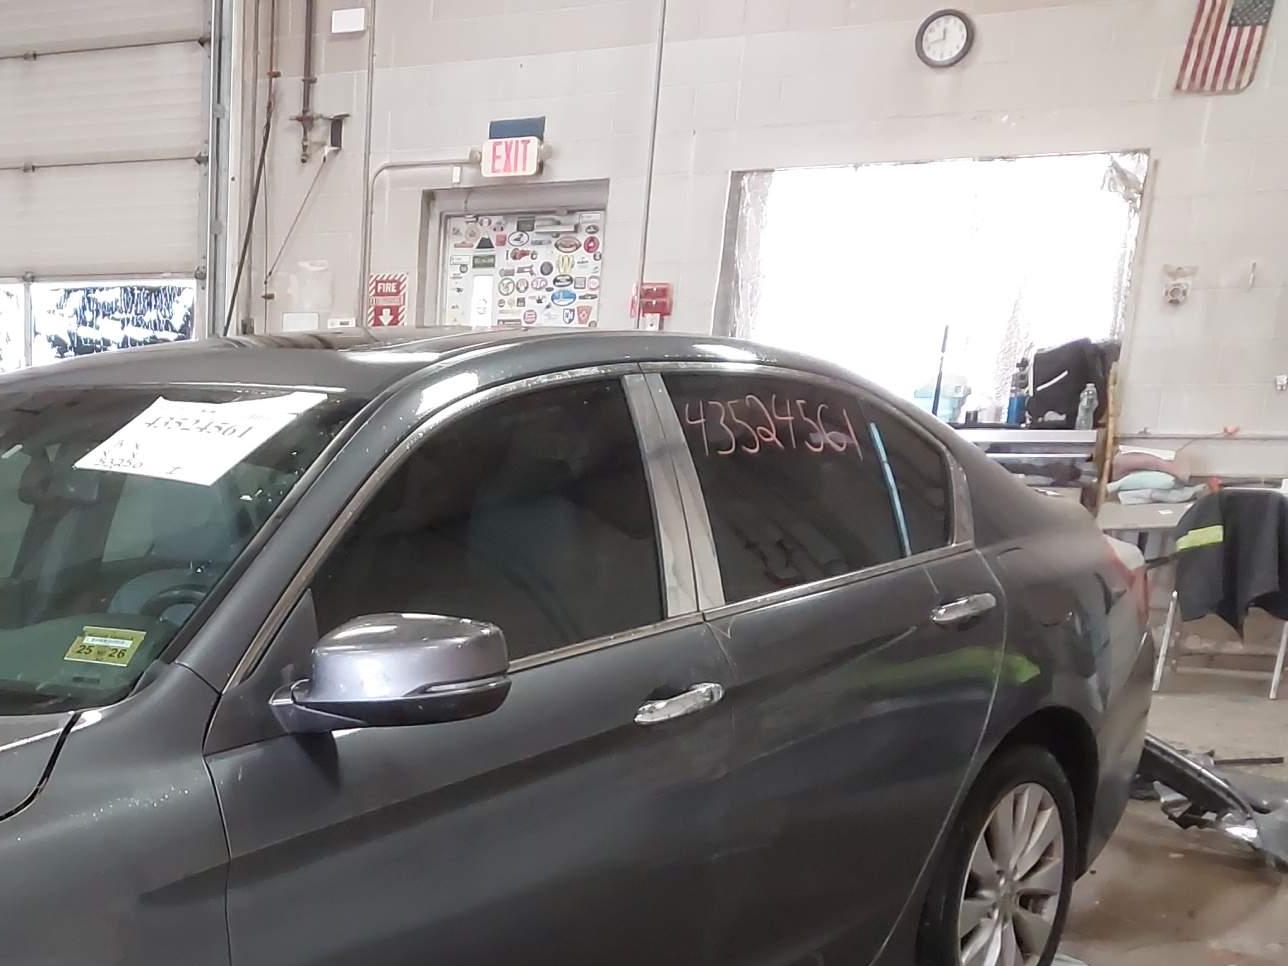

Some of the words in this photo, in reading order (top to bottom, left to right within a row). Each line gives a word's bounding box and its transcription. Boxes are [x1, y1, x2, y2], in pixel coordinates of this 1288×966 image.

[491, 139, 531, 173] EXIT
[377, 282, 397, 293] FIRE
[684, 394, 864, 462] 43524561
[76, 645, 94, 655] 25
[108, 648, 127, 658] 26
